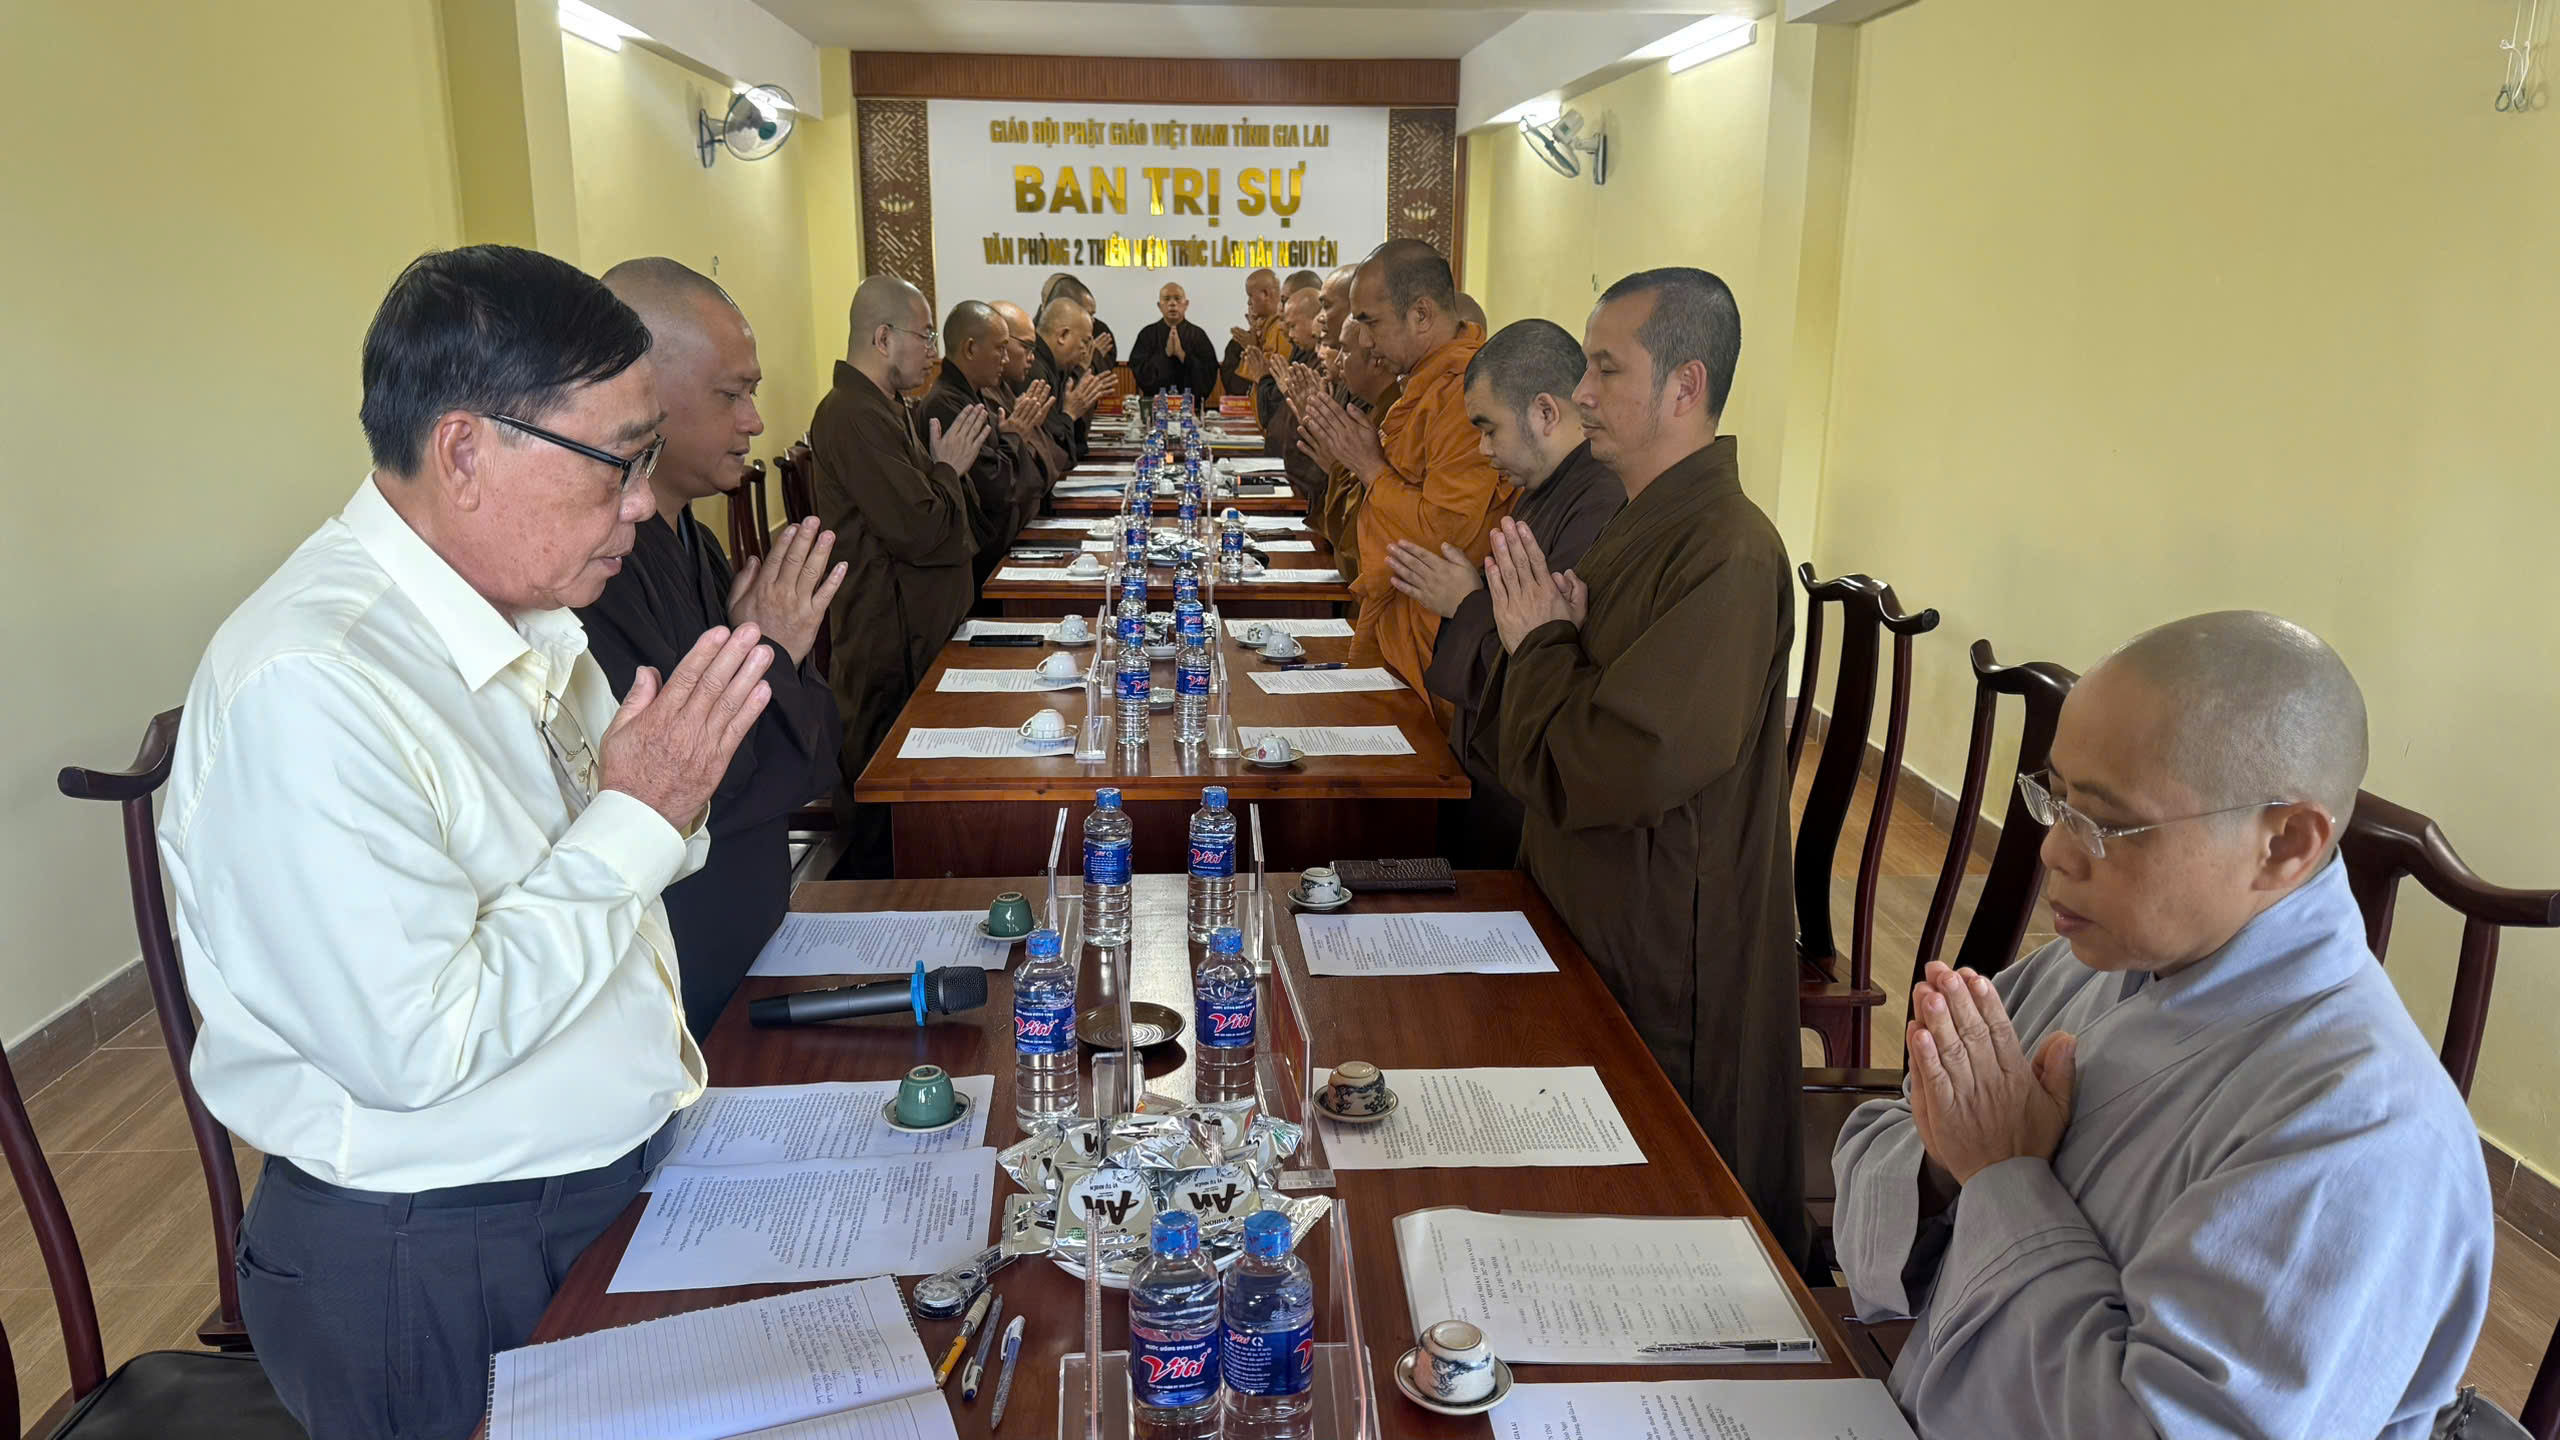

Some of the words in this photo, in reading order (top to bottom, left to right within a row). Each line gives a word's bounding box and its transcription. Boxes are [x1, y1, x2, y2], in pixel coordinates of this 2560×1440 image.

[989, 116, 1029, 144] GIÁO
[1032, 117, 1059, 148] HỘI
[1063, 118, 1106, 148] PHẬT
[1109, 119, 1148, 146] GIÁO
[1151, 120, 1188, 150] VIỆT
[1191, 123, 1228, 147] NAM
[1232, 117, 1270, 147] TỈNH
[1273, 124, 1299, 147] GIA
[1303, 124, 1329, 147] LAI
[1013, 165, 1128, 215] BAN
[1142, 167, 1220, 228] TRỊ
[1237, 160, 1306, 228] SỰ
[983, 232, 1015, 265] VĂN
[1018, 232, 1070, 266] PHÒNG
[1074, 239, 1084, 266] 2
[1087, 231, 1131, 267] THIỀN
[1133, 232, 1168, 270] VIỆN
[1170, 234, 1208, 267] TRÚC
[1211, 235, 1246, 268] LÂM
[1248, 234, 1273, 268] TÂY
[1278, 235, 1338, 268] NGUYÊN
[1187, 1184, 1245, 1213] An
